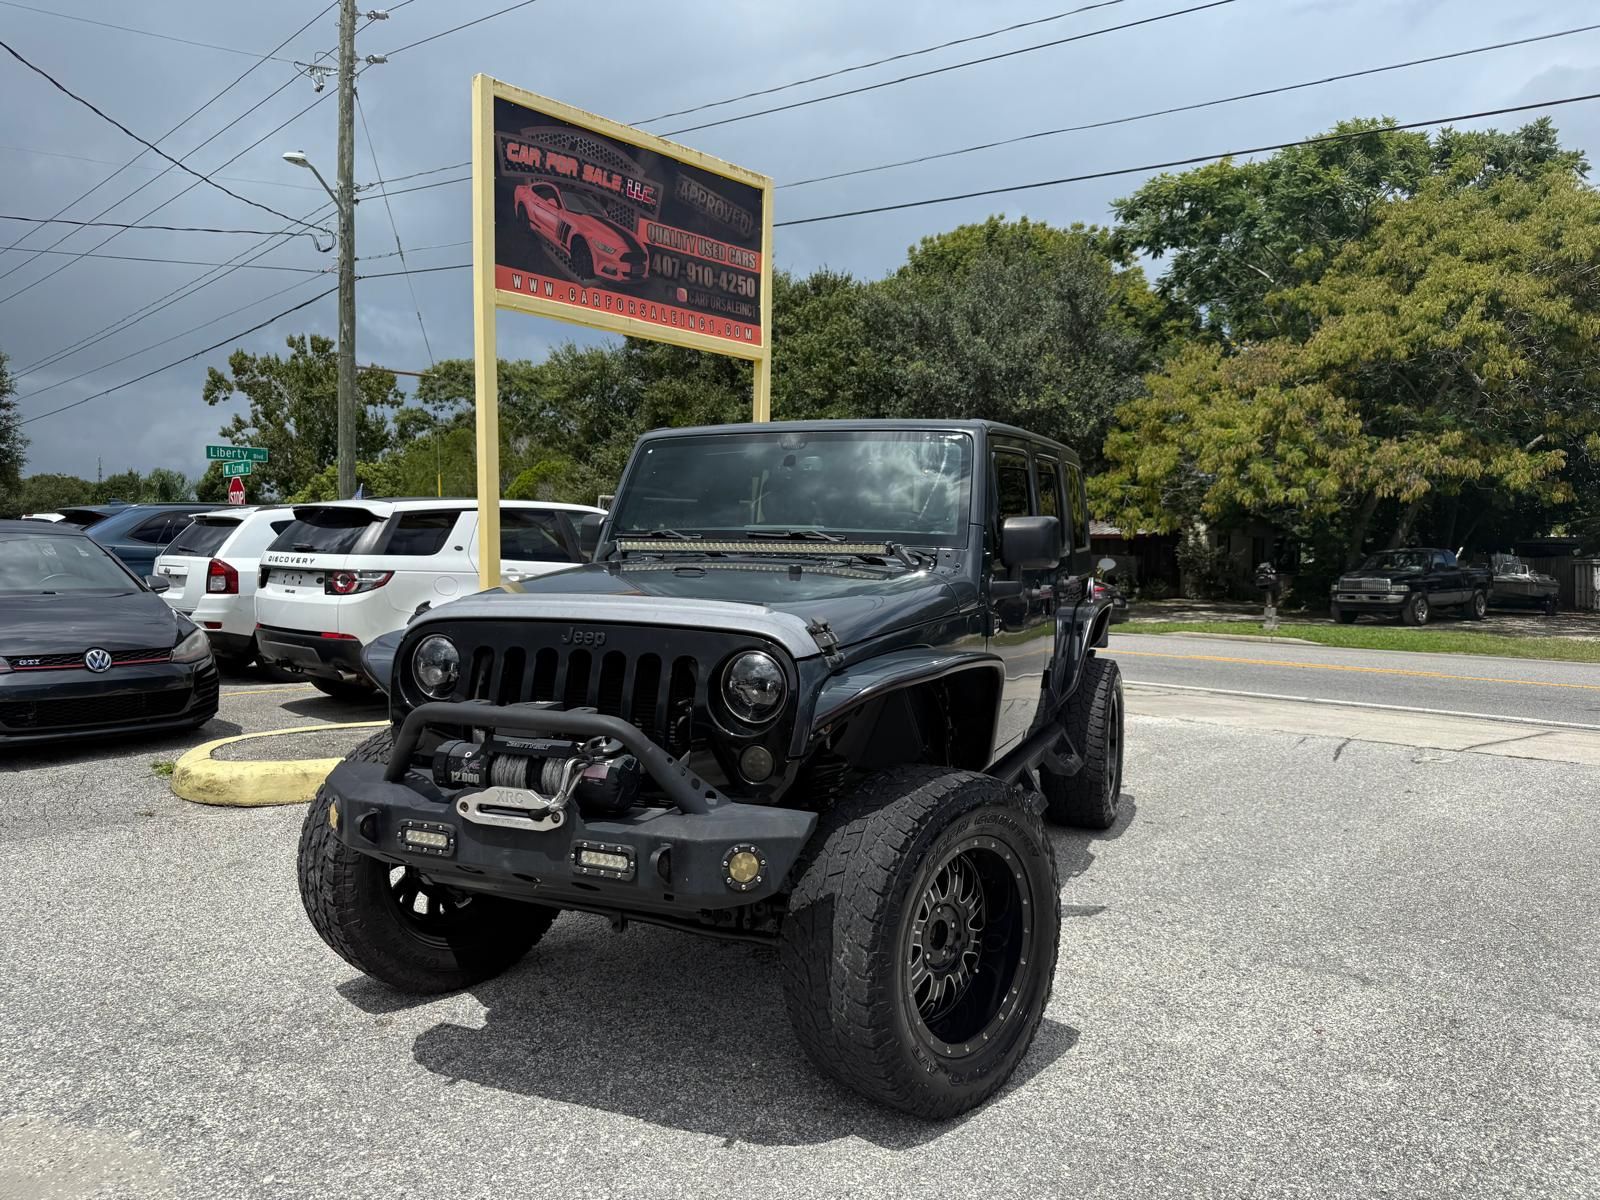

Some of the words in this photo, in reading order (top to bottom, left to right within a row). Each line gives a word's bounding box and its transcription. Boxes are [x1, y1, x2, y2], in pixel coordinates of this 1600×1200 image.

[506, 142, 541, 168] CAR
[545, 151, 578, 178] FOR
[582, 163, 622, 192] SALE
[680, 181, 751, 233] APPROVED
[647, 223, 697, 254] QUALITY
[698, 239, 726, 261] USED
[728, 247, 756, 269] CARS
[652, 253, 756, 298] 407-910-4250
[210, 447, 248, 461] Liberty
[230, 491, 244, 504] STOP
[268, 555, 316, 565] DISCOVERY
[561, 626, 607, 649] Jeep
[496, 790, 524, 804] XRC
